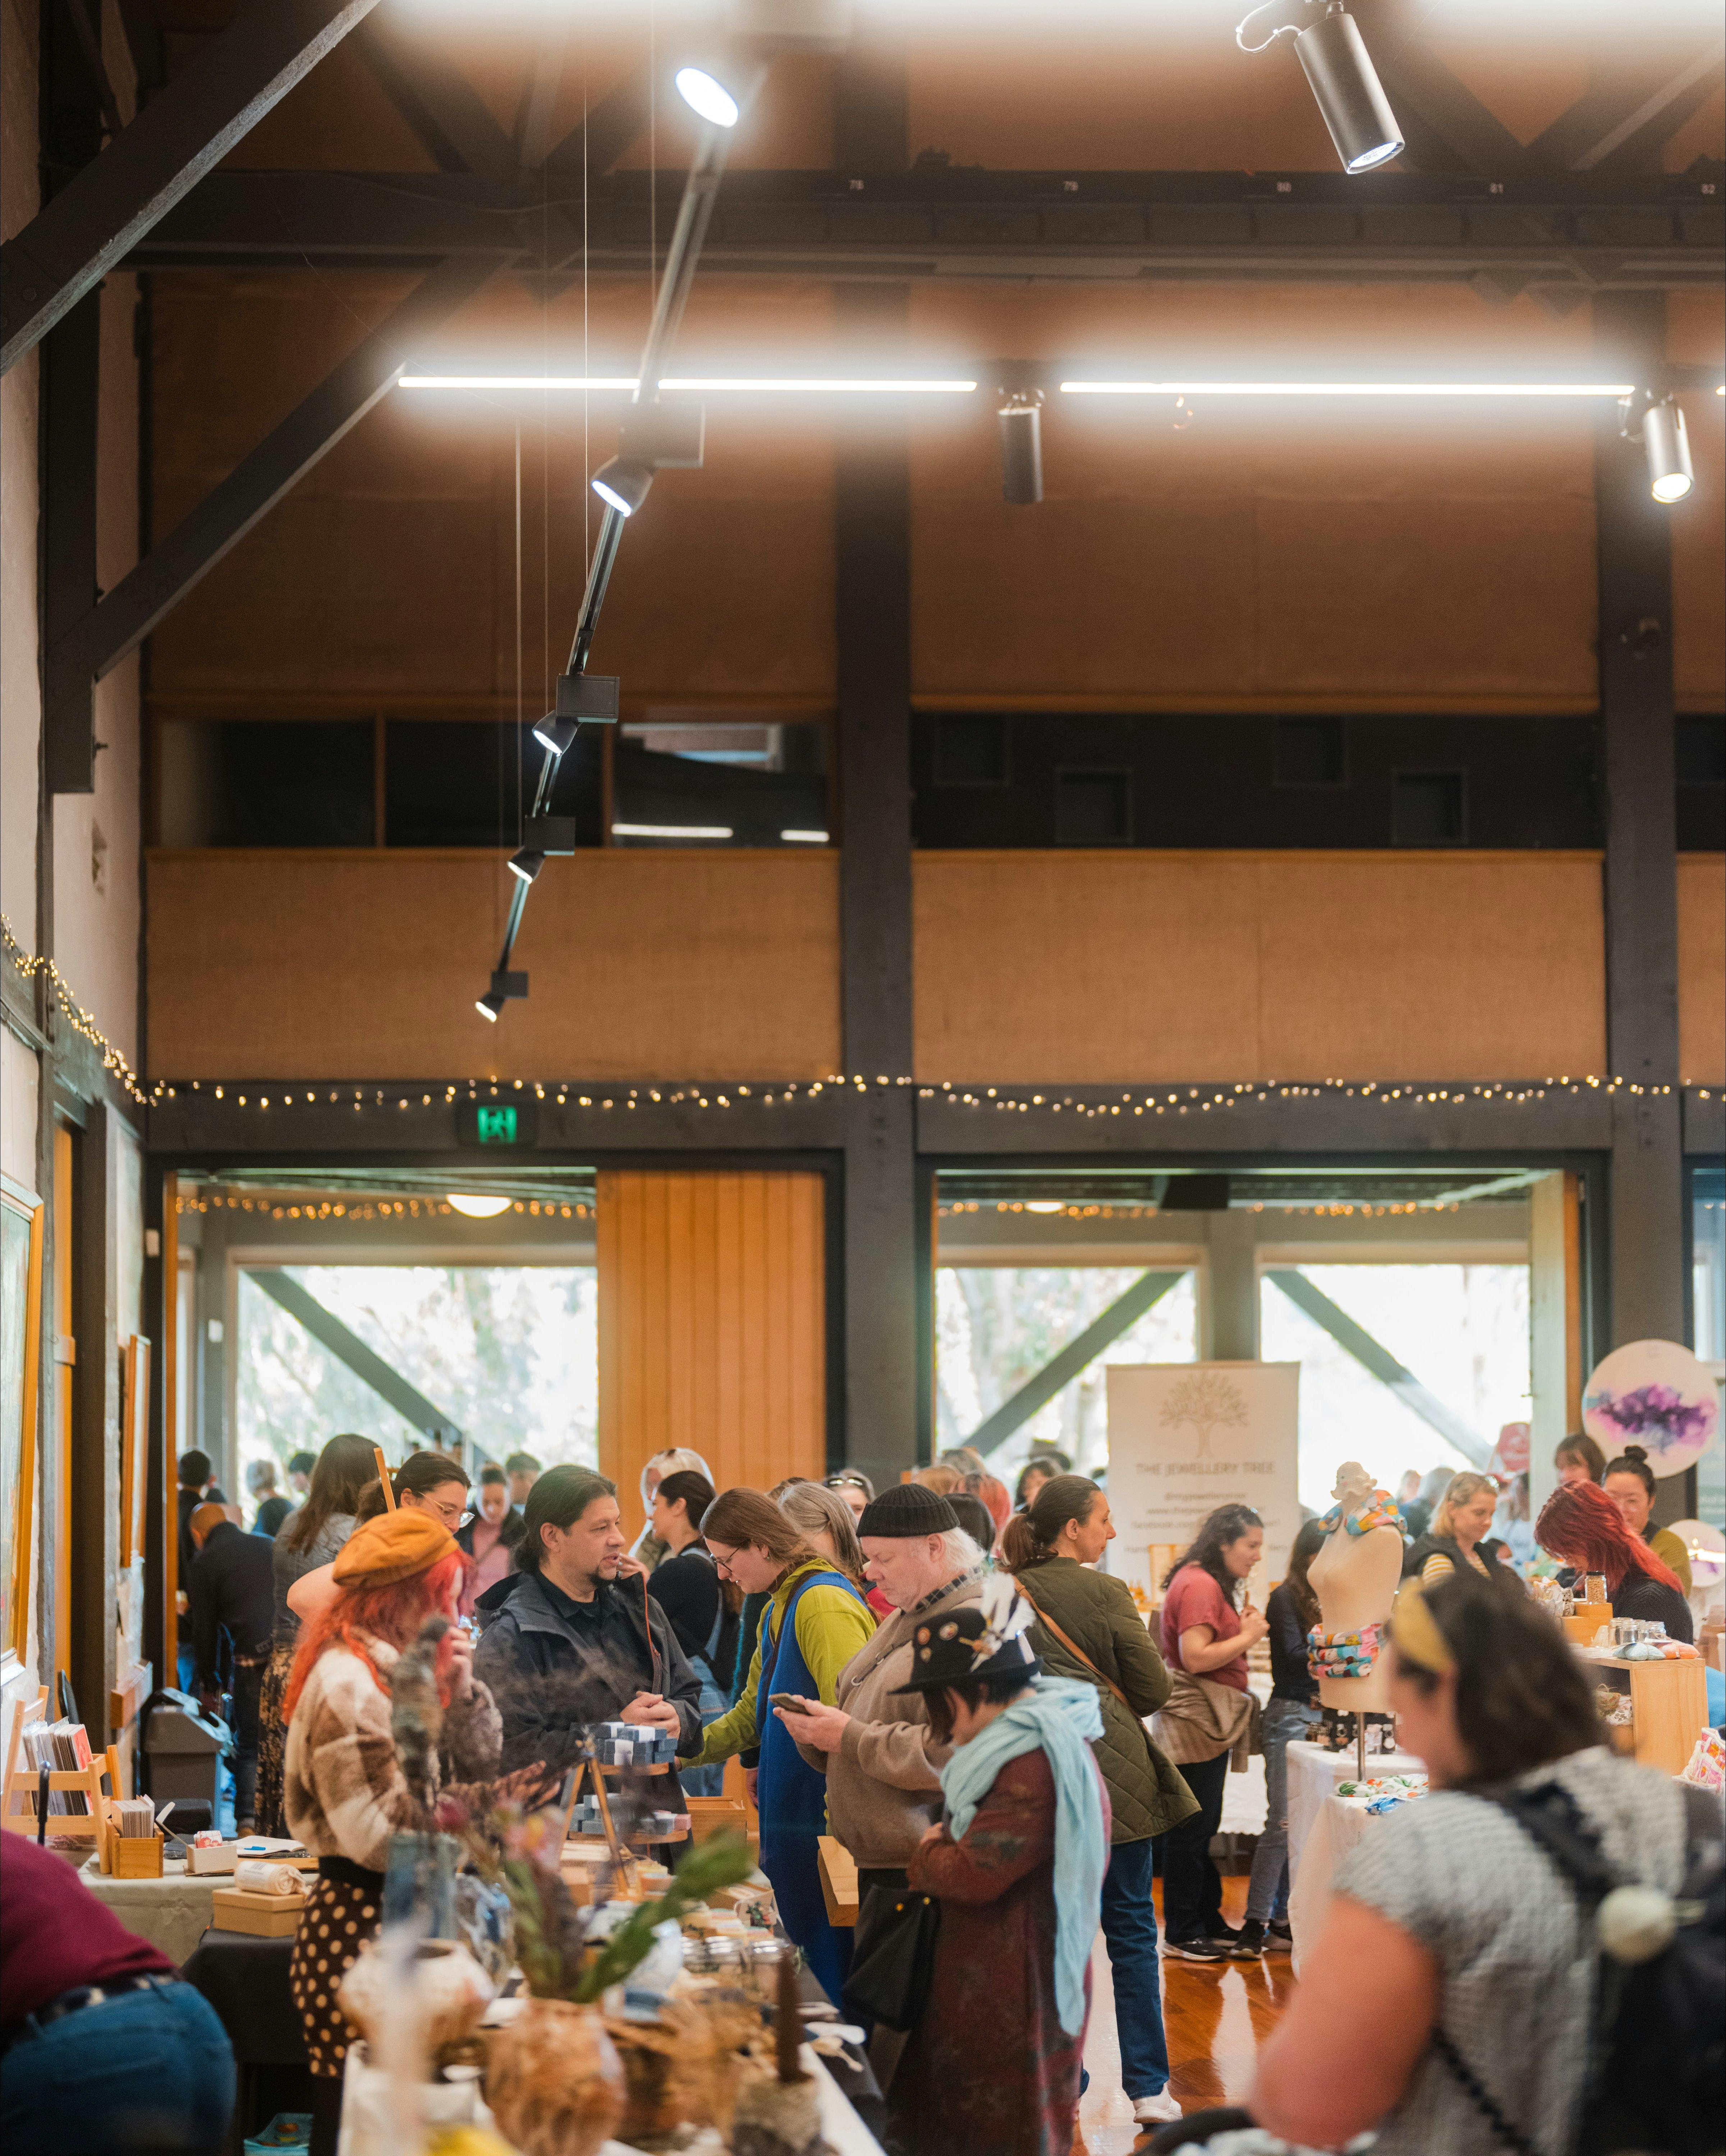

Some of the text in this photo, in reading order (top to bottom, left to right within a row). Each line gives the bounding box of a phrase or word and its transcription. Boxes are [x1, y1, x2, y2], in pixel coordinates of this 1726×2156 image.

[1489, 183, 1504, 194] 81
[1136, 1461, 1275, 1477] THE JEWELLERY TREE
